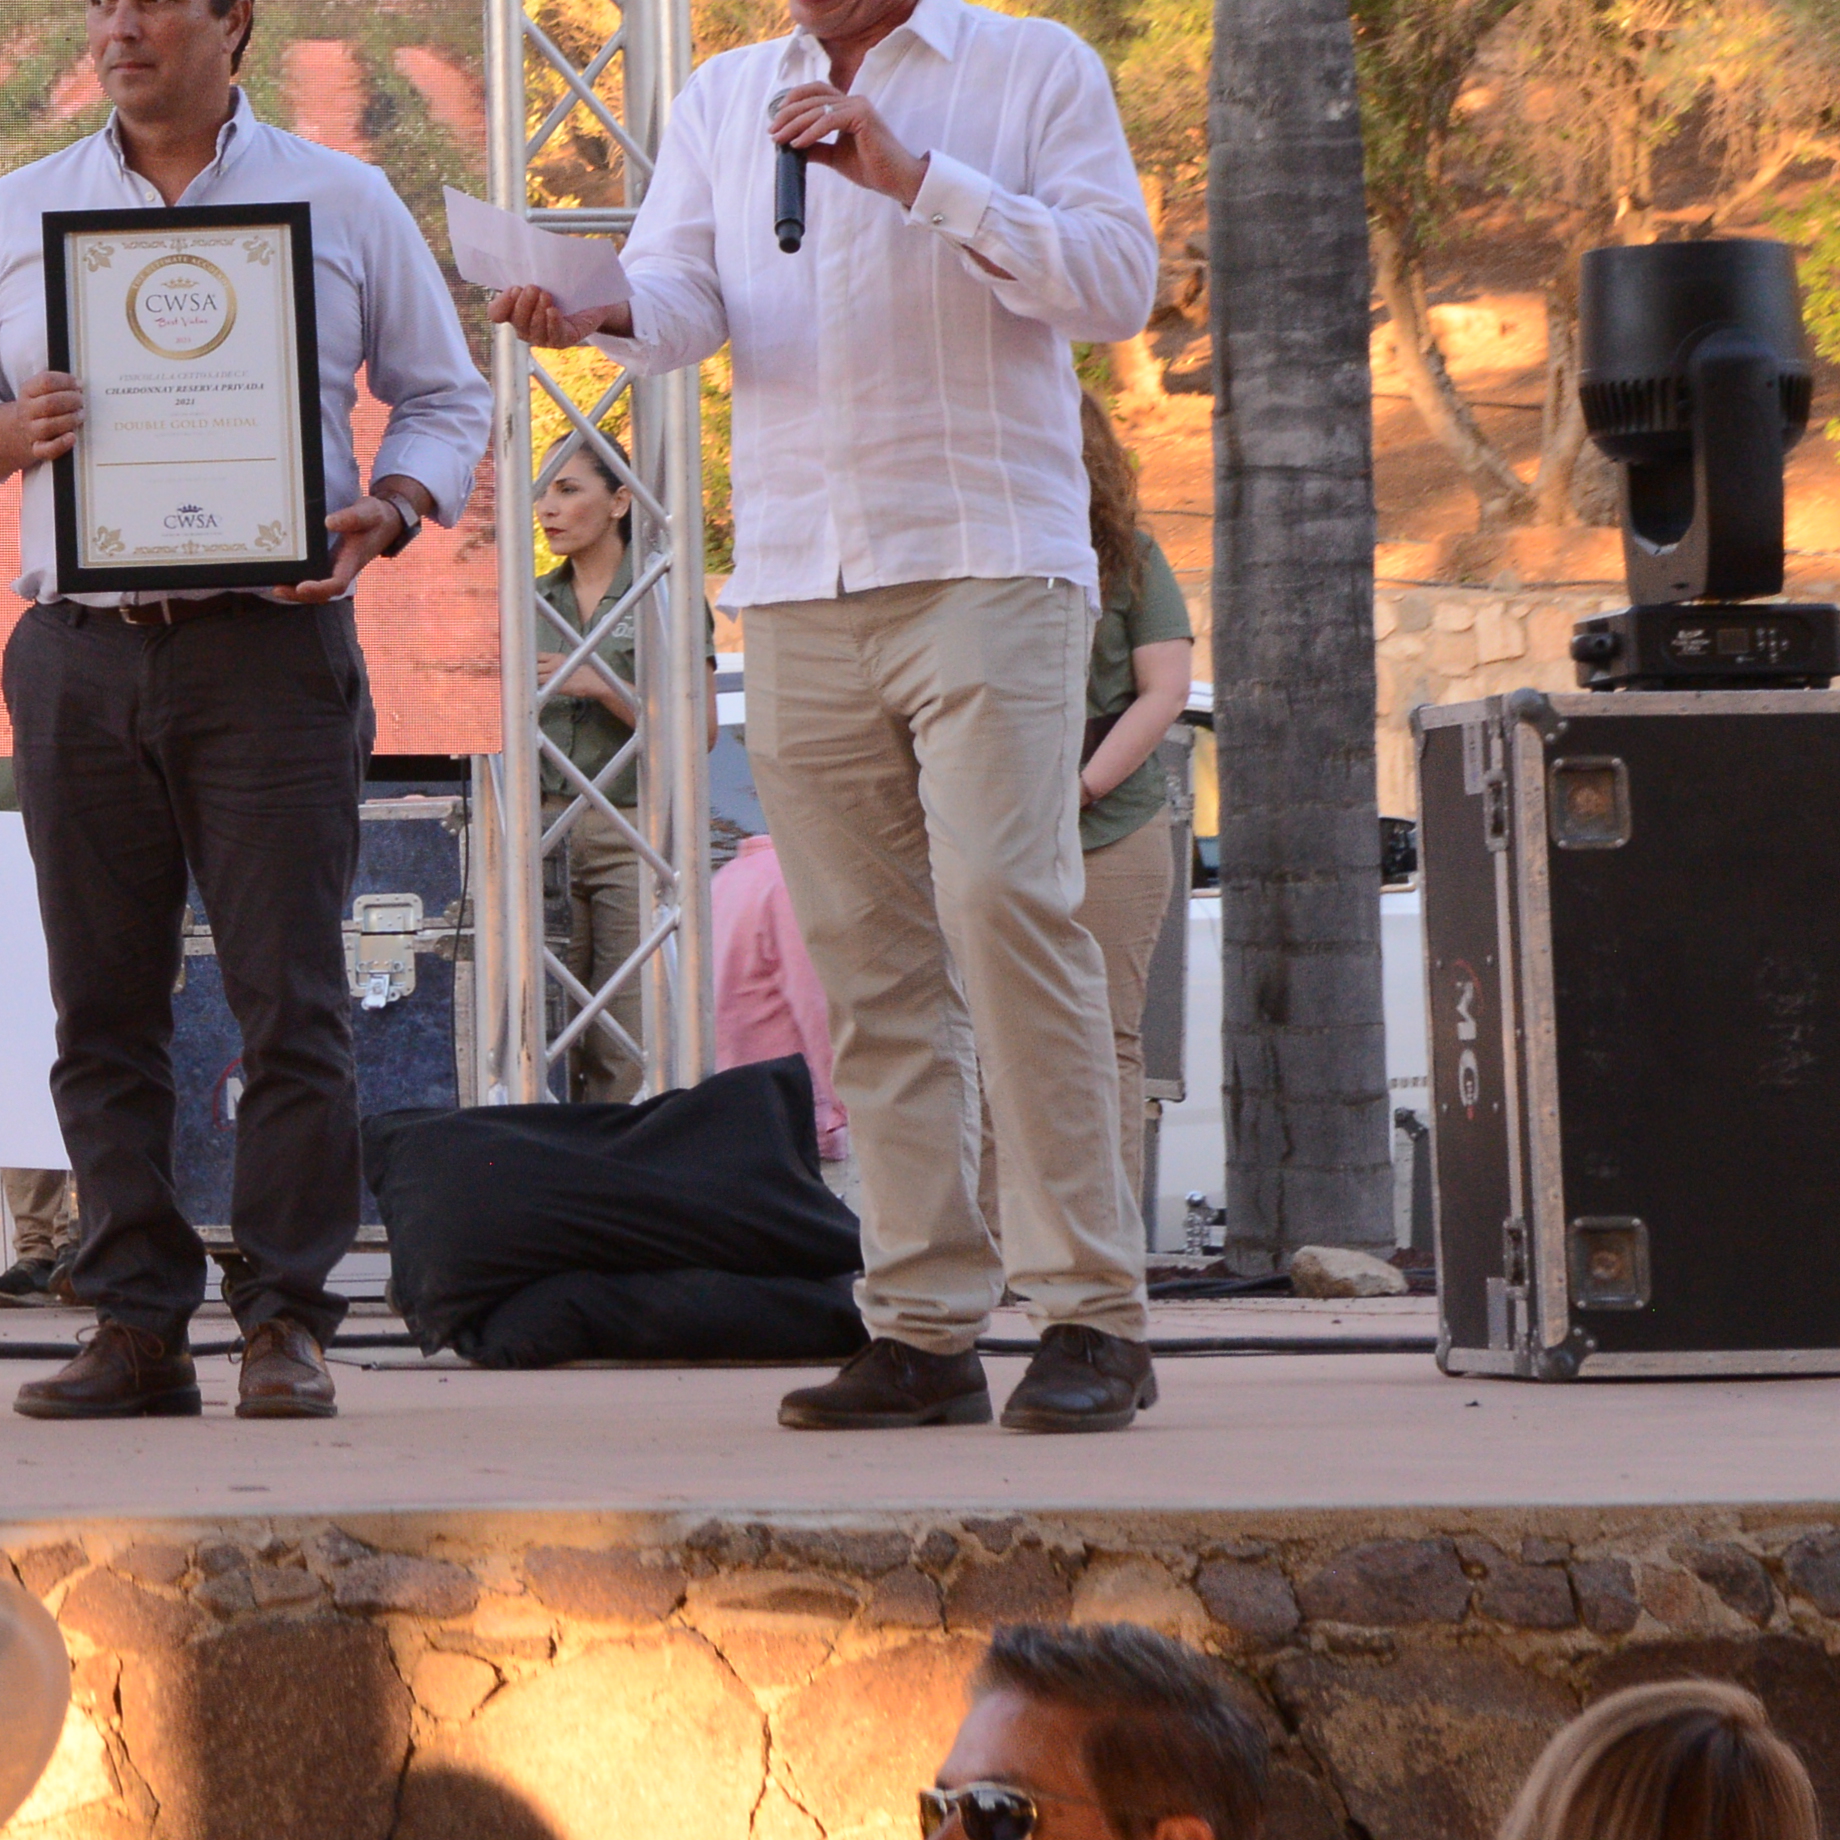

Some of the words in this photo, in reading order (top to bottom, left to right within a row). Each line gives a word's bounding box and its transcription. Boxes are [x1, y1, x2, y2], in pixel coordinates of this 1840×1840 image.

[145, 293, 218, 313] CWSA
[155, 317, 178, 328] Best
[105, 386, 173, 396] CHARDONNAY
[176, 385, 220, 394] RESERVA
[221, 383, 265, 392] PRIVADA
[114, 420, 166, 432] DOUBLE
[170, 418, 208, 430] GOLD
[212, 417, 258, 428] MEDAL
[163, 514, 219, 530] CWSA
